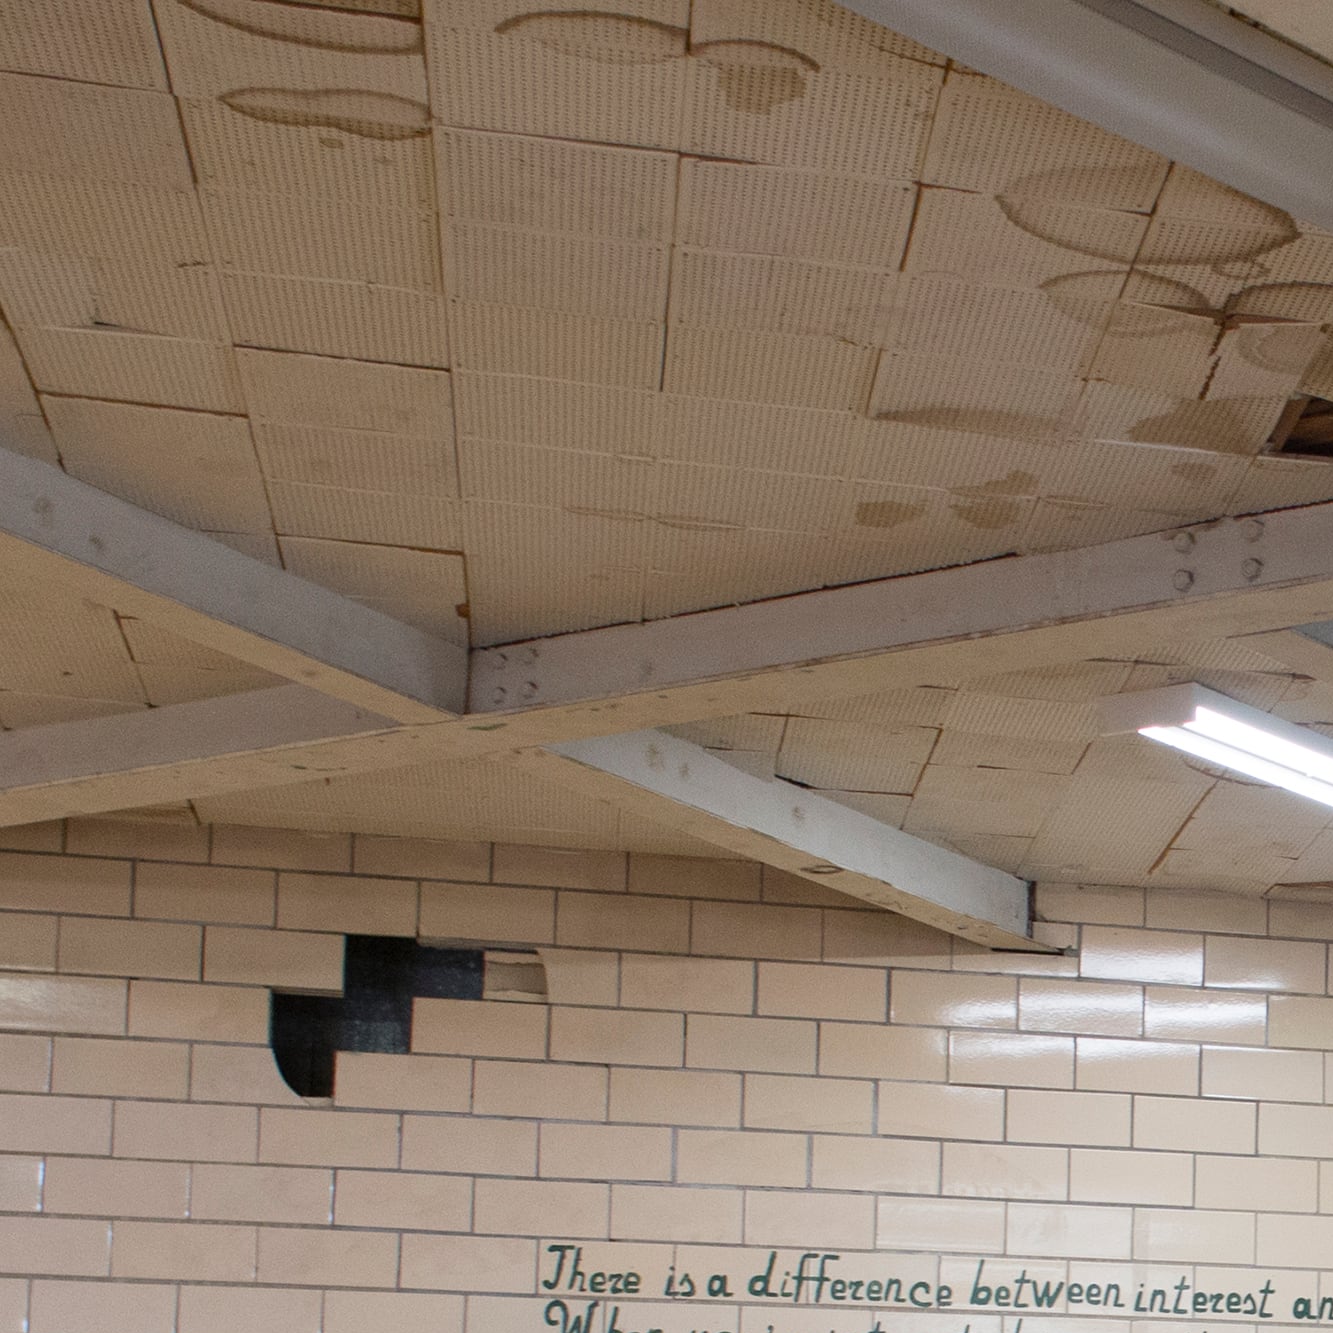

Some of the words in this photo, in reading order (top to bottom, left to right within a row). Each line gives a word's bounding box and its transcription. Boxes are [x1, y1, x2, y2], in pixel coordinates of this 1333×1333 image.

[542, 1244, 641, 1294] There
[663, 1265, 695, 1297] is
[707, 1276, 733, 1297] a
[747, 1251, 952, 1305] difference
[969, 1259, 1125, 1308] between
[1133, 1275, 1275, 1317] interest
